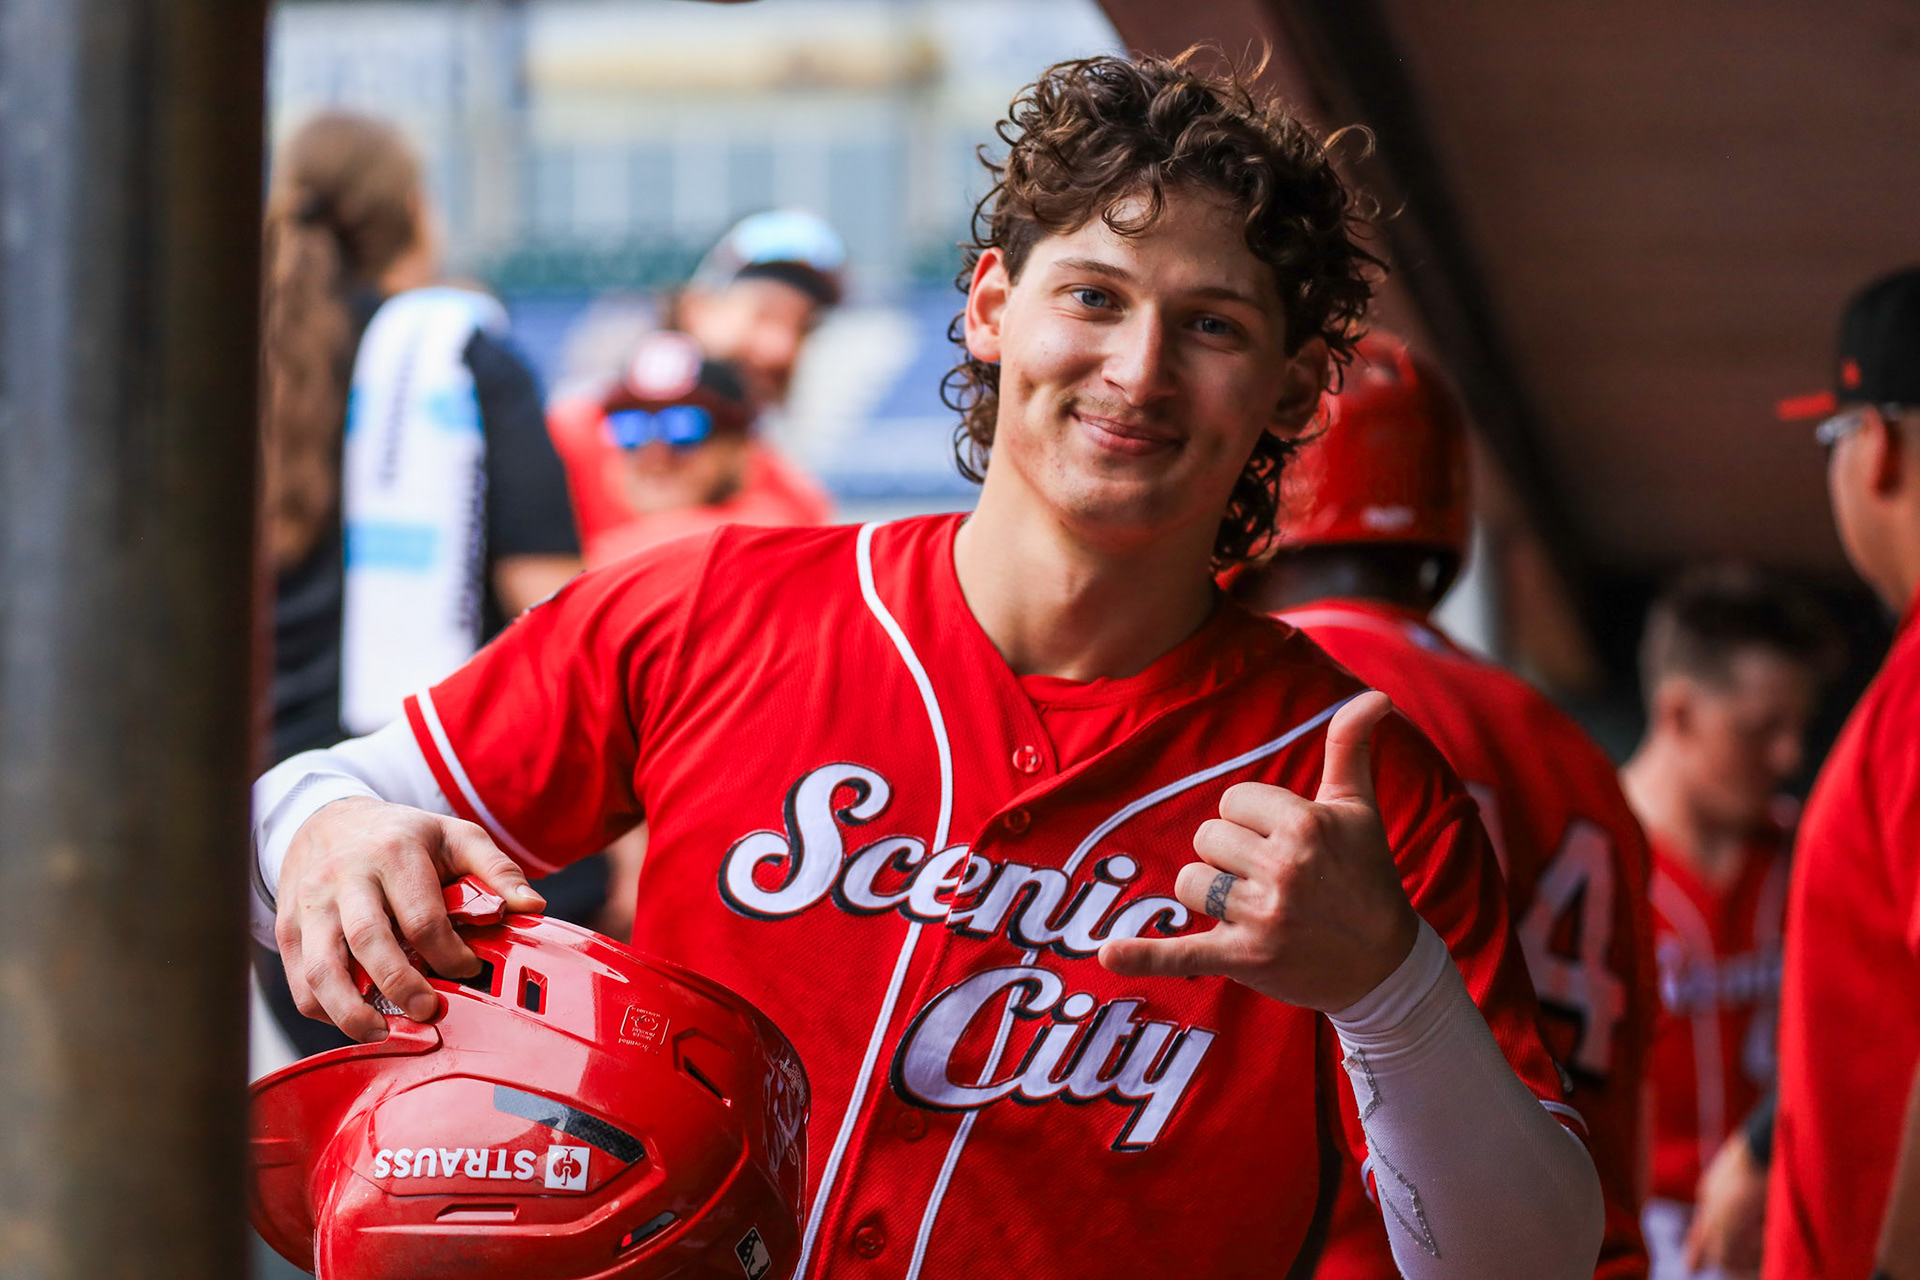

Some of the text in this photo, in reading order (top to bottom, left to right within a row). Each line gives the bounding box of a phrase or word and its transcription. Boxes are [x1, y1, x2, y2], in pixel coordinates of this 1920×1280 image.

[717, 762, 1192, 959] Scenic
[889, 965, 1220, 1152] City
[374, 1147, 538, 1181] STRAUSS
